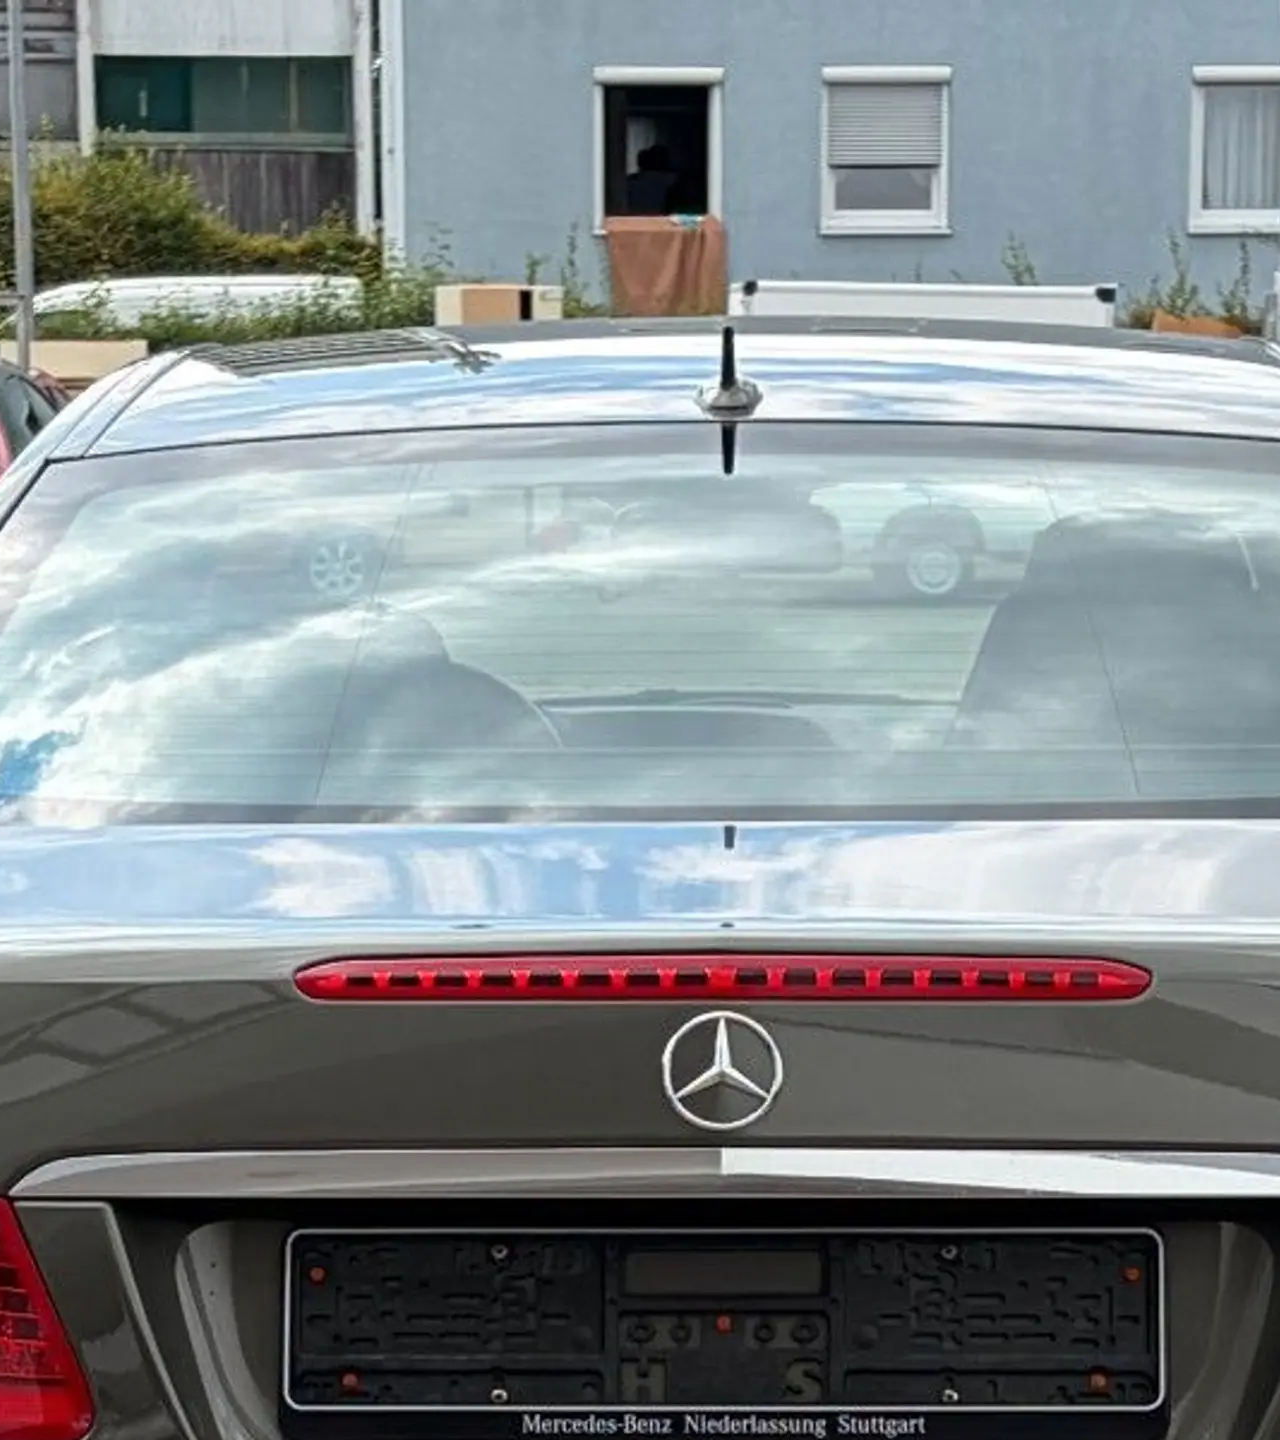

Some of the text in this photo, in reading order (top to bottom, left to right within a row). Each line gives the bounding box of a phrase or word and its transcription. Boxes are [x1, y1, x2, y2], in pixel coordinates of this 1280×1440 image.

[521, 1413, 927, 1438] Mercedes-Benz Niederlassung Stuttgart
